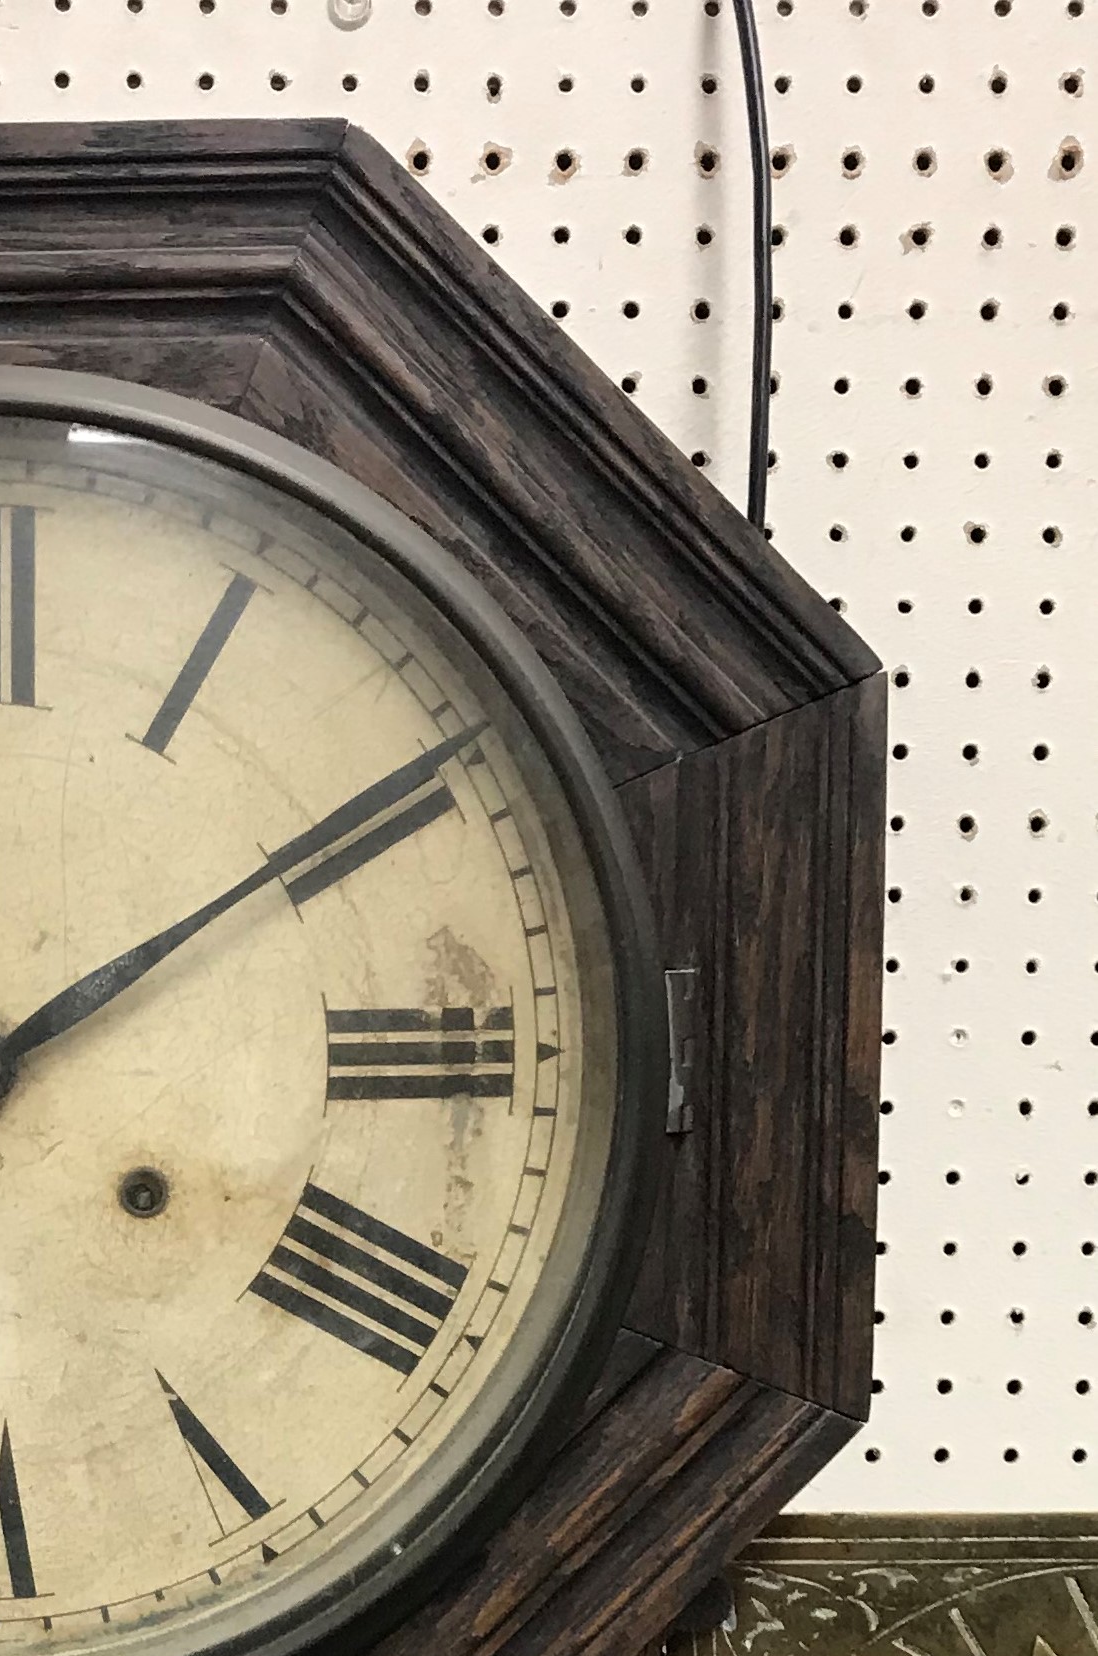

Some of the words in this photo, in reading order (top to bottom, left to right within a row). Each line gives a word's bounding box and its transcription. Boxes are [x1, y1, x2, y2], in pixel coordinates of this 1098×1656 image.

[125, 568, 275, 764] I
[322, 987, 515, 1116] III
[236, 1165, 475, 1393] IIII
[154, 1366, 285, 1548] V
